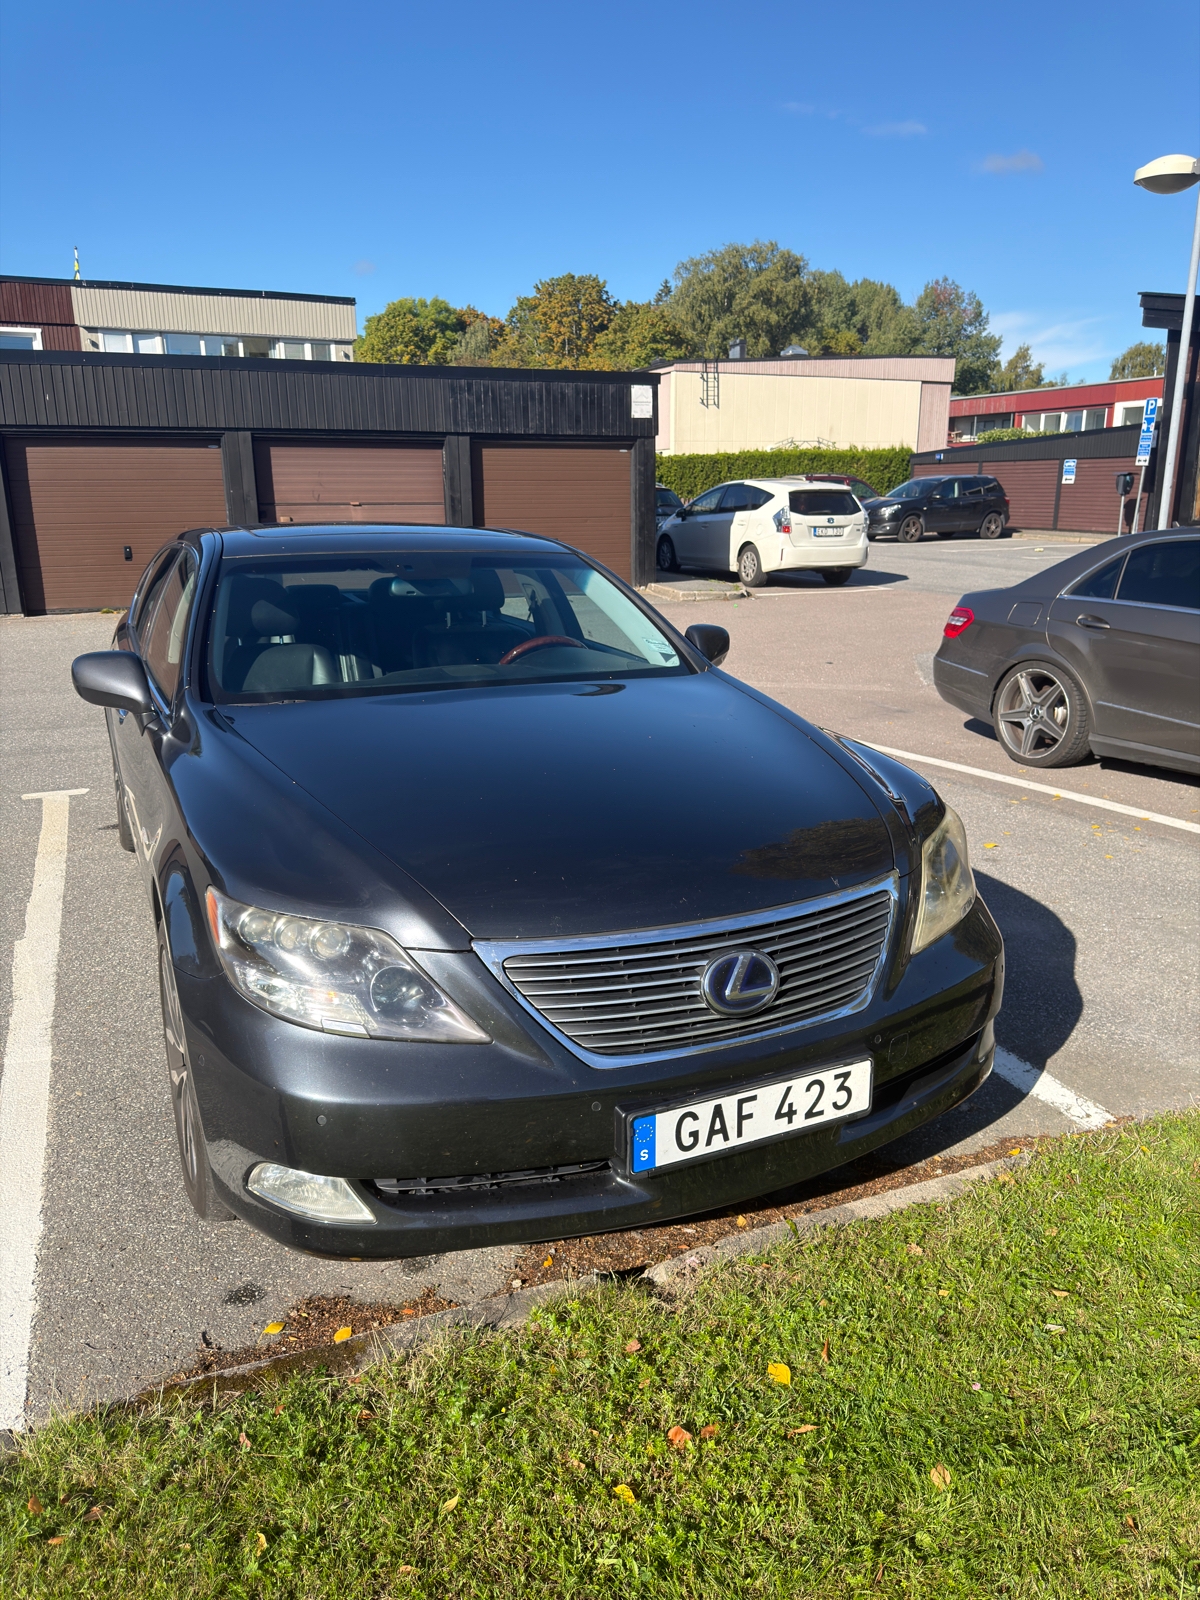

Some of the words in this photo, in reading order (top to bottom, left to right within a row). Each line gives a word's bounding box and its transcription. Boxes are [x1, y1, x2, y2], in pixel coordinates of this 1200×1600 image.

[1148, 399, 1156, 415] P
[675, 1095, 758, 1152] GAF
[774, 1071, 853, 1125] 423
[640, 1149, 649, 1161] S
